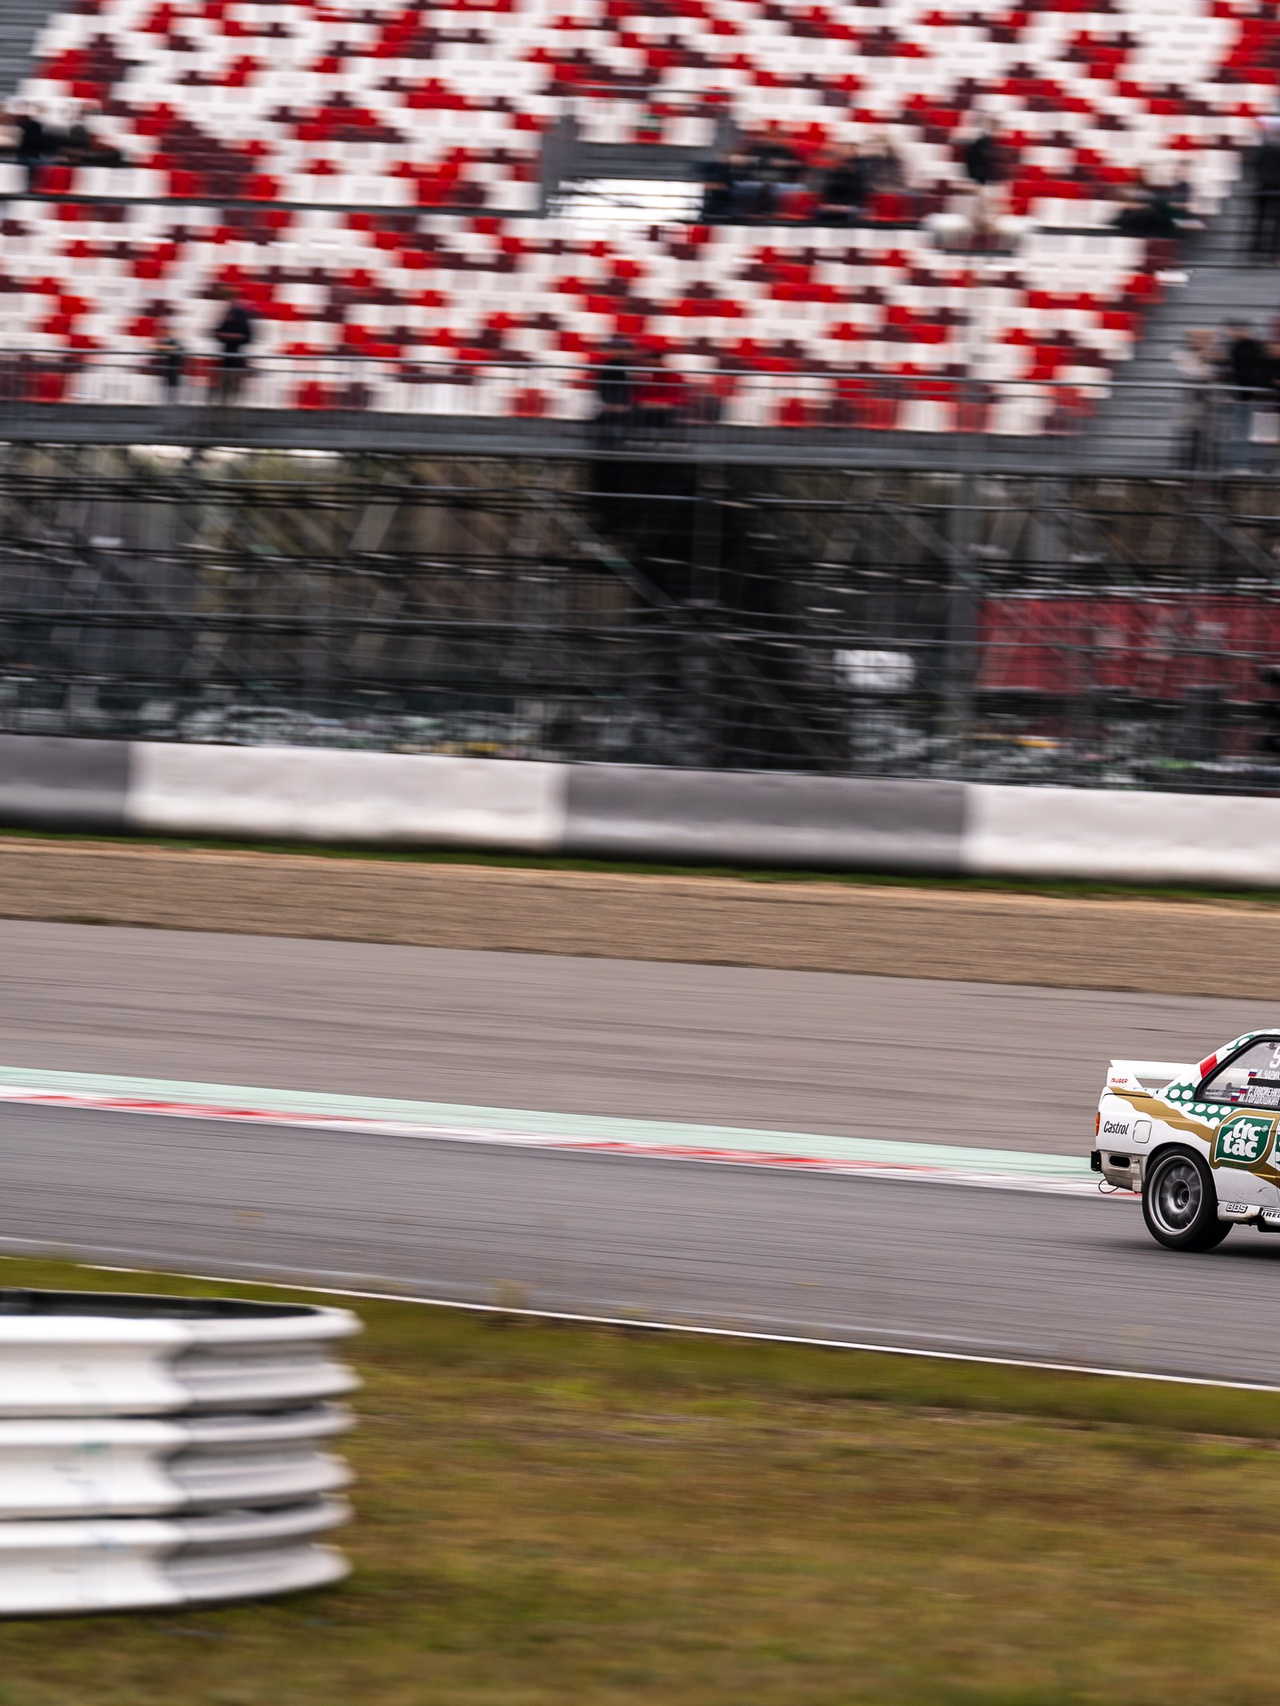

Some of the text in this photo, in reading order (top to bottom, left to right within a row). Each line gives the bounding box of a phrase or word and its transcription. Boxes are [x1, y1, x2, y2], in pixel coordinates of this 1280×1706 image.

[1103, 1120, 1130, 1135] Castrol
[1233, 1119, 1262, 1142] tic
[1223, 1131, 1258, 1159] tac
[1226, 1203, 1248, 1214] BBS
